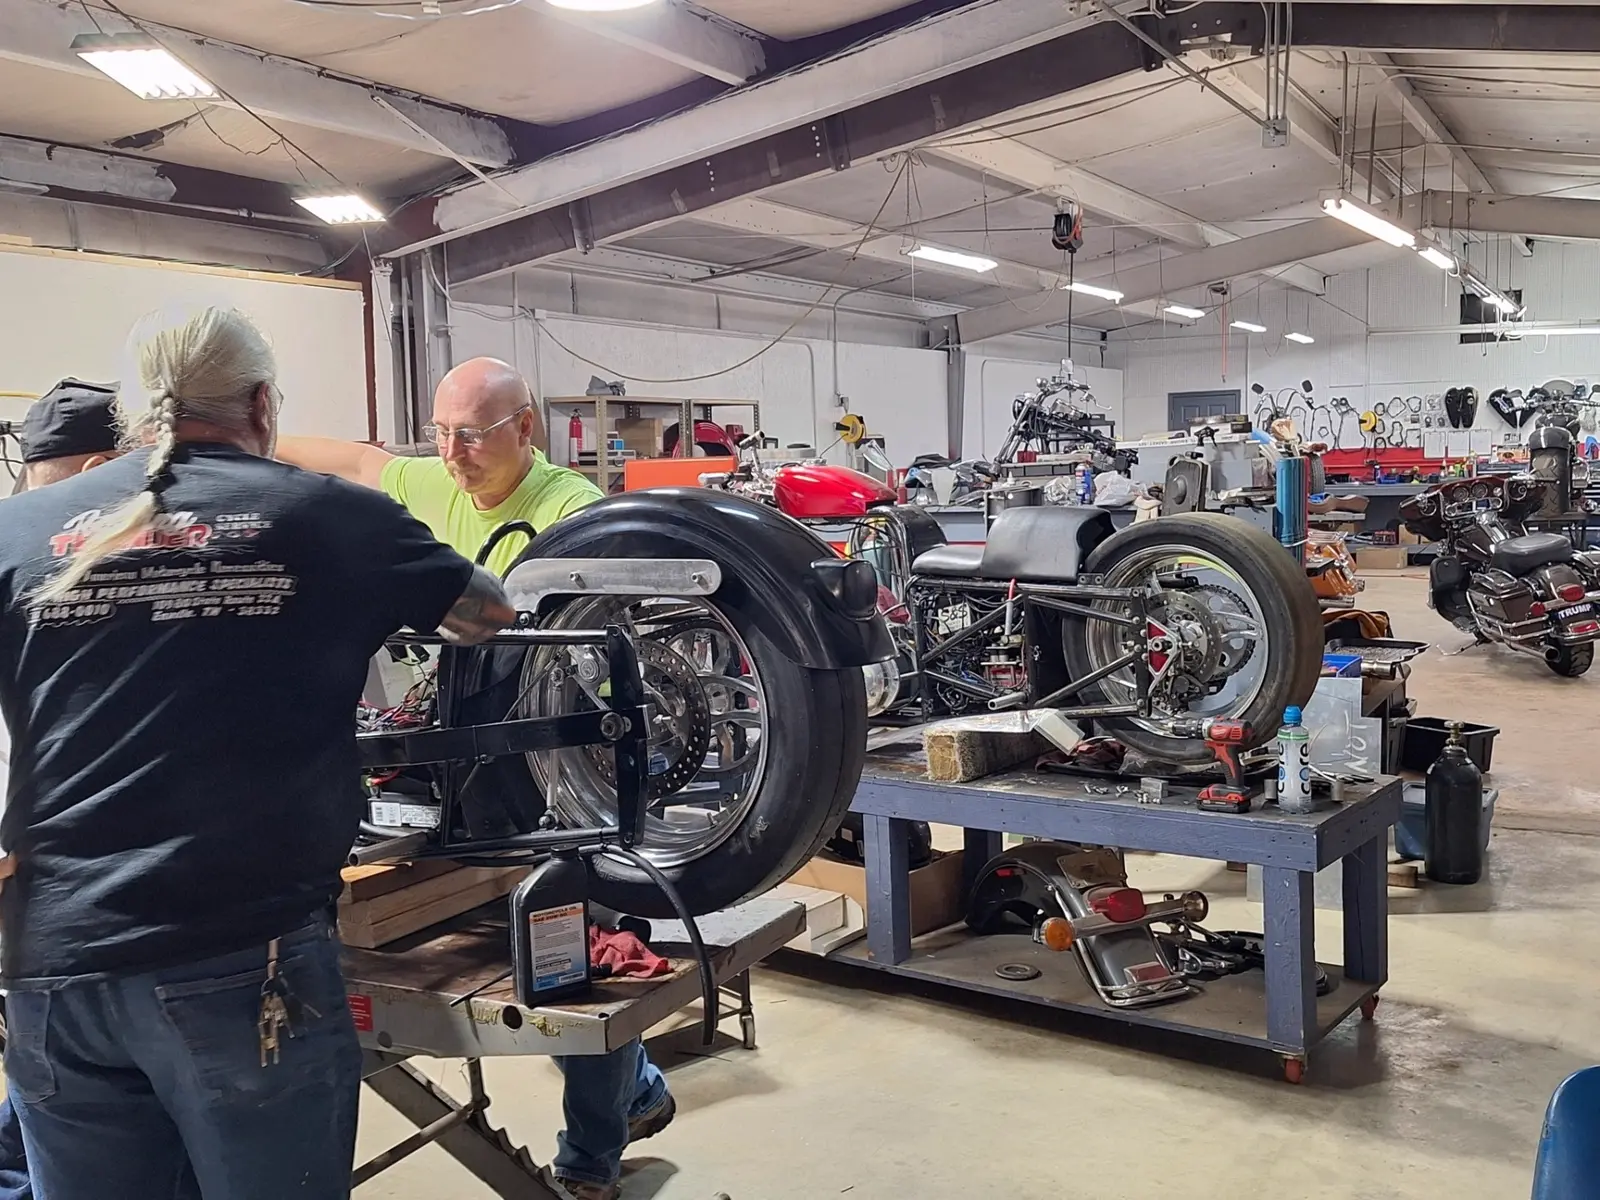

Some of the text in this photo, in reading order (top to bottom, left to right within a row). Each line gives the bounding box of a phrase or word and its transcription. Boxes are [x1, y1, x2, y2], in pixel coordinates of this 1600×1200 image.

[215, 513, 261, 522] CYCLE
[49, 524, 212, 556] TDER
[96, 580, 207, 600] PERFORMANCE
[209, 577, 294, 590] SPECIALISTS
[941, 604, 968, 622] S&S
[1558, 603, 1592, 619] TRUMP
[1299, 742, 1311, 795] core
